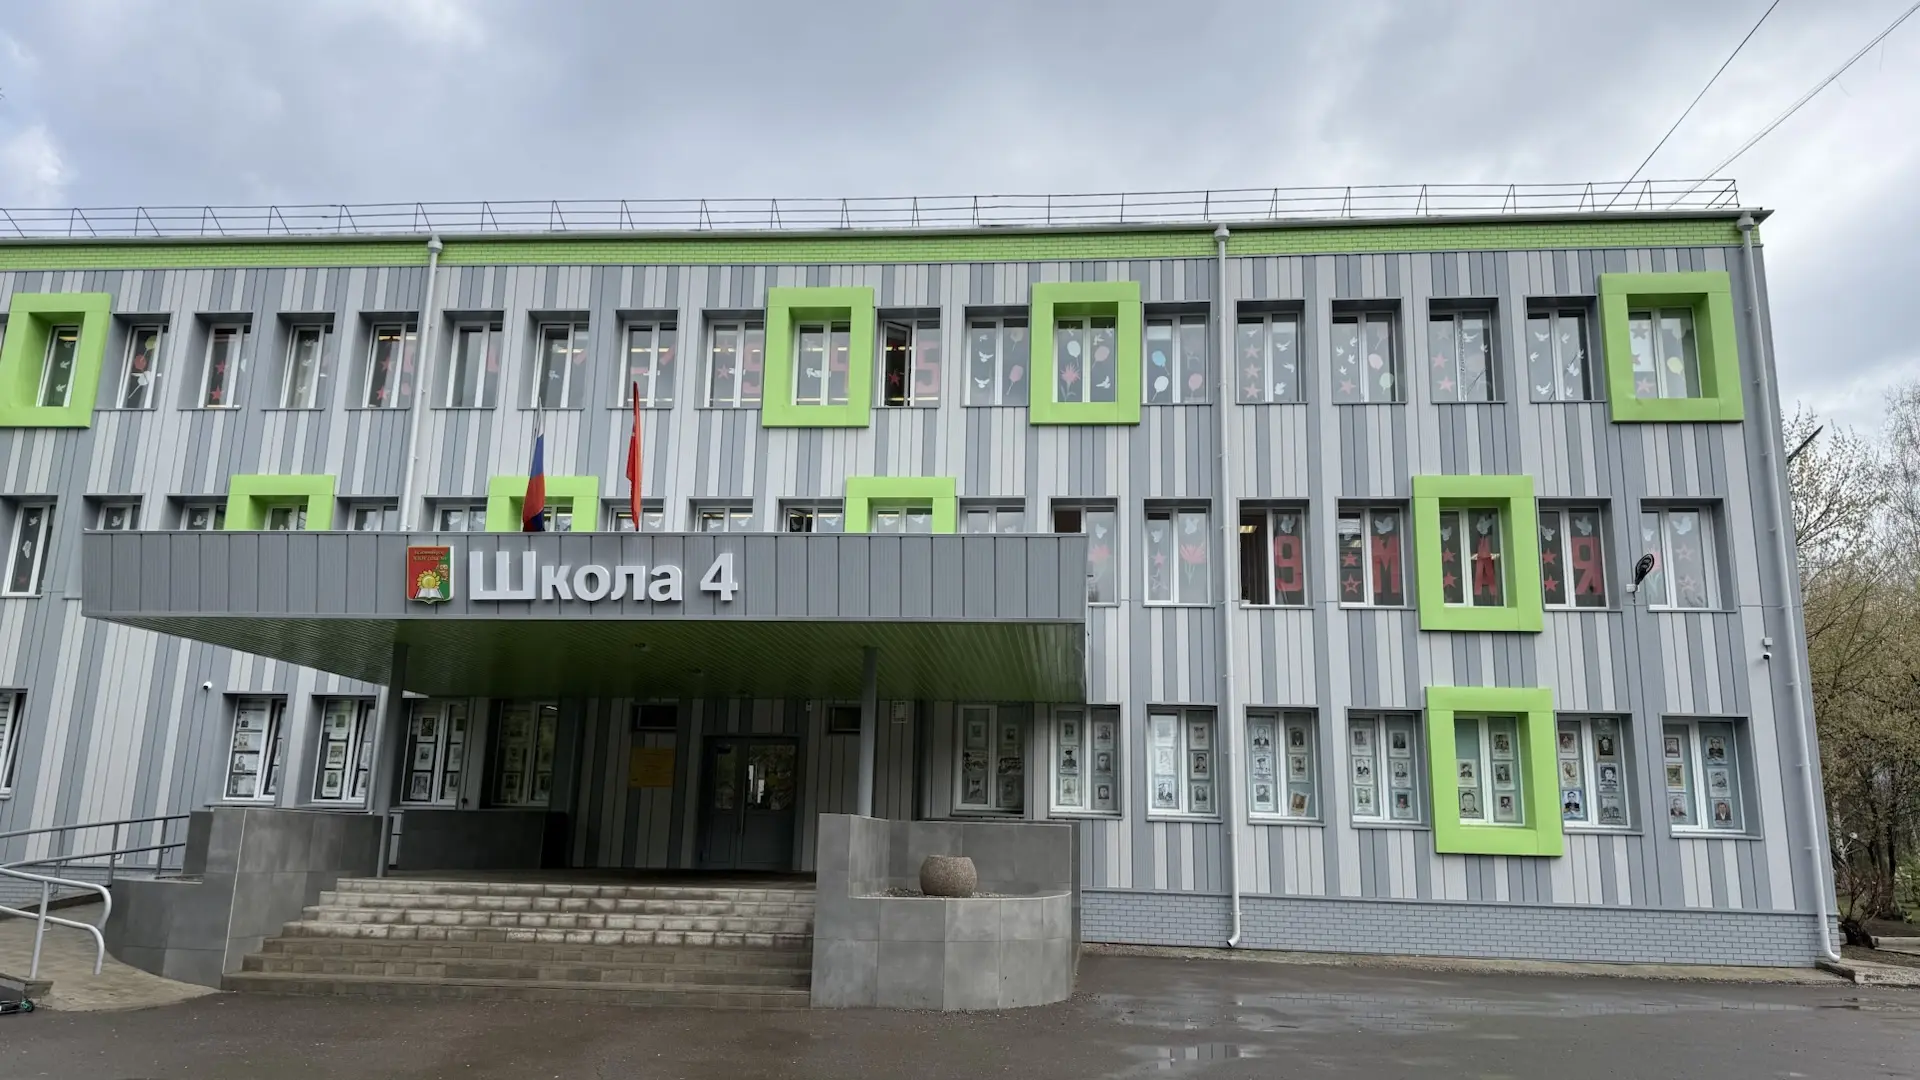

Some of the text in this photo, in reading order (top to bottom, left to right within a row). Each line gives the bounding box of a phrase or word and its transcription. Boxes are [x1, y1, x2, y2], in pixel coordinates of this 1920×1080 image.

[469, 550, 739, 602] Школа 4
[1274, 535, 1605, 596] 9 МАЯ
